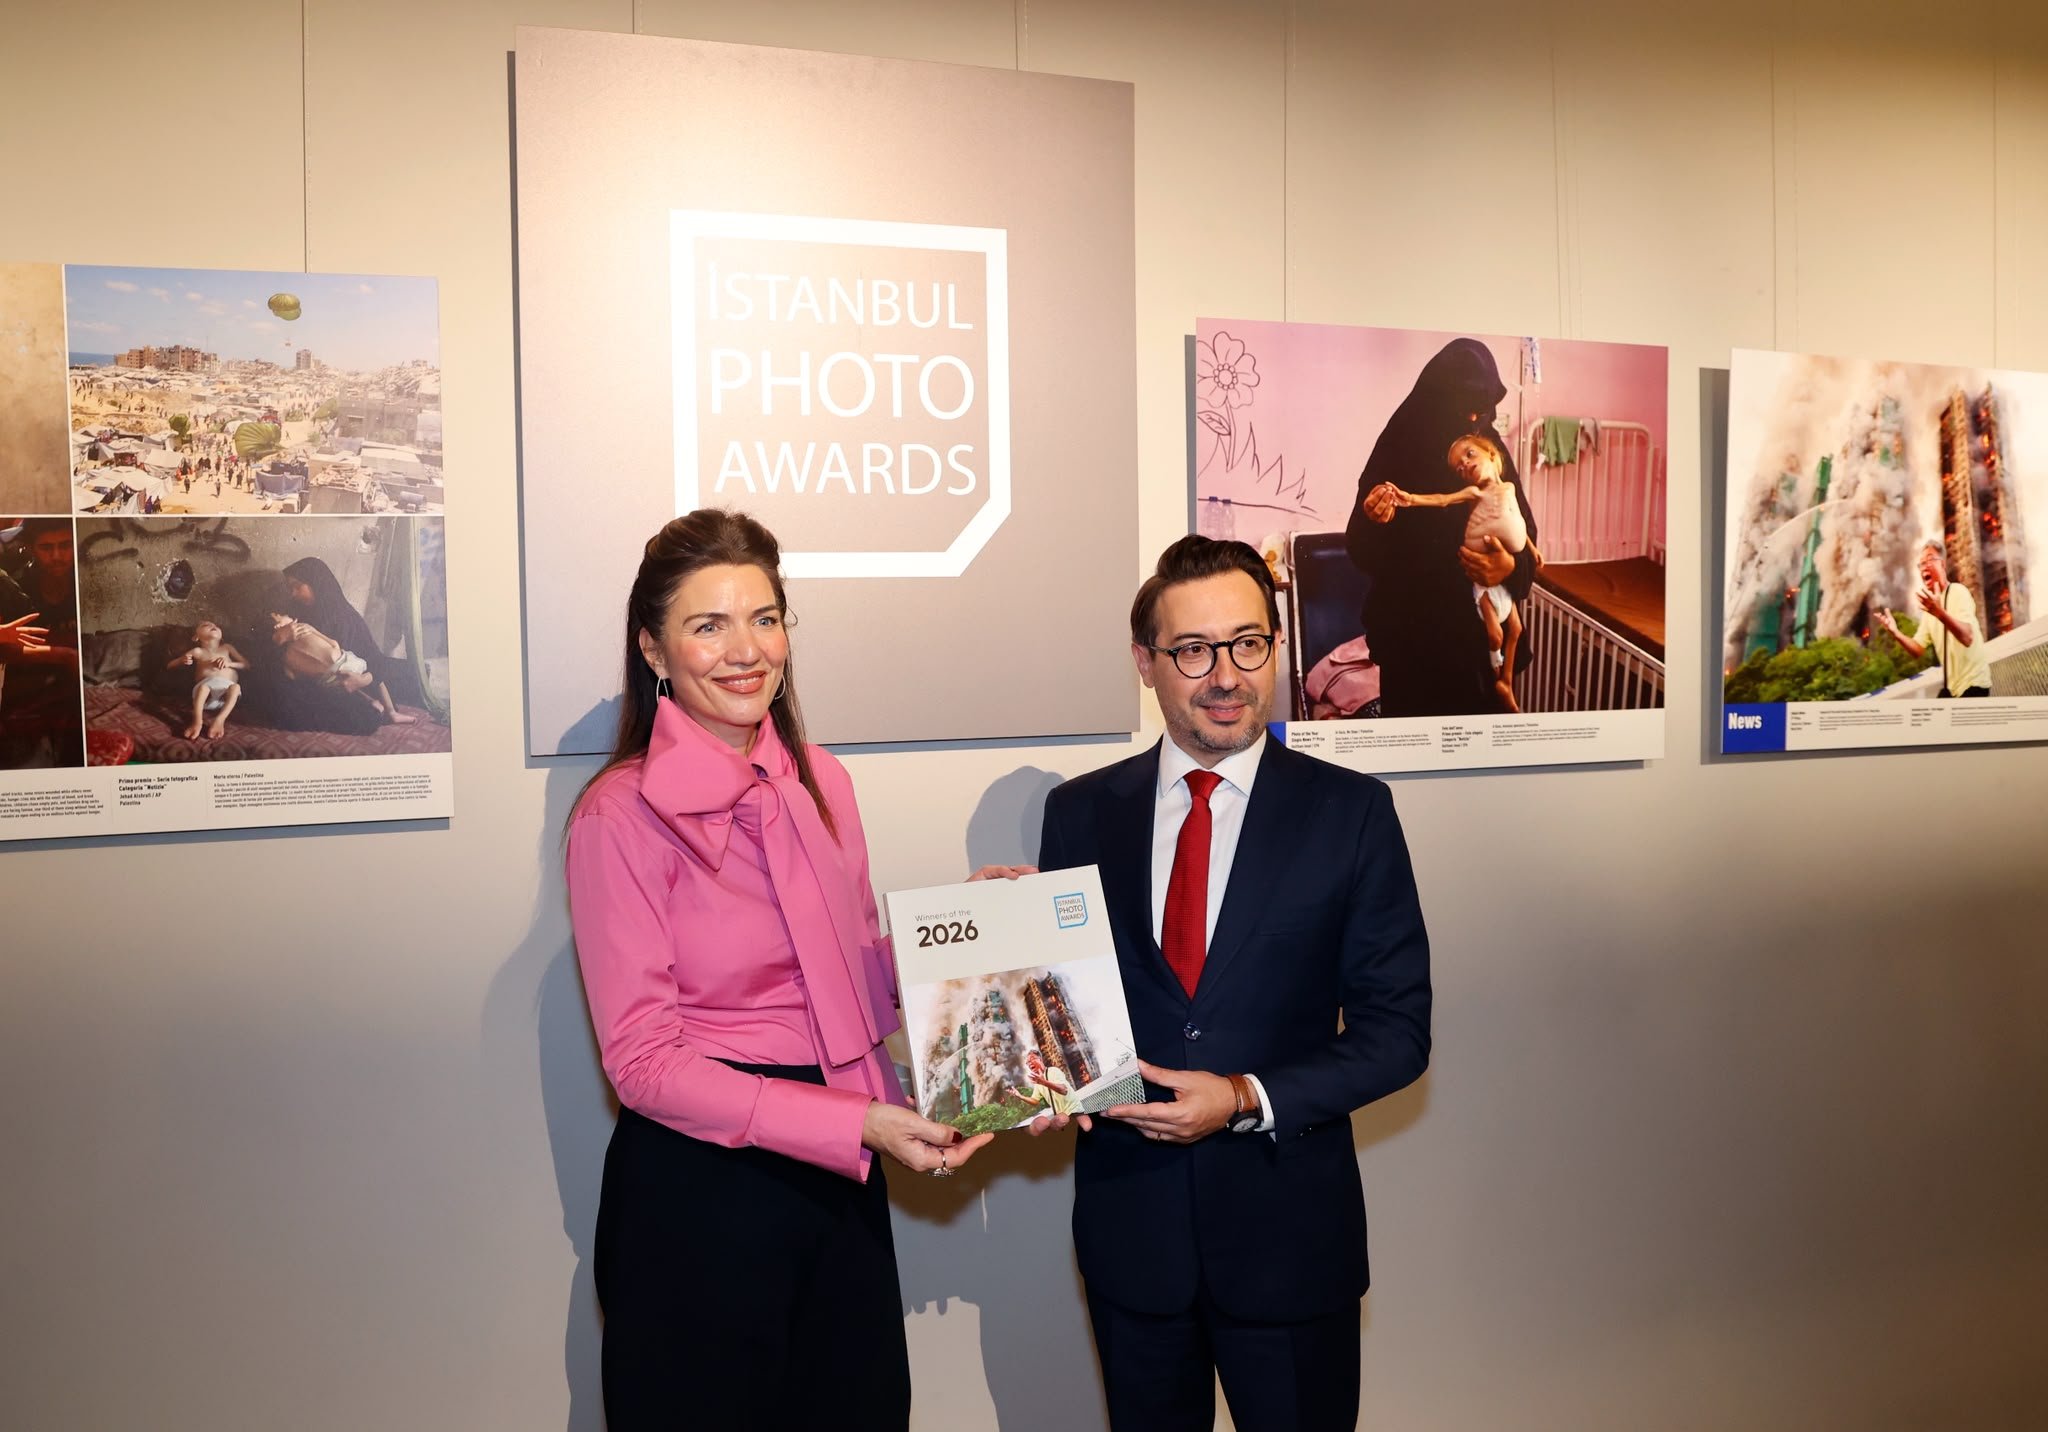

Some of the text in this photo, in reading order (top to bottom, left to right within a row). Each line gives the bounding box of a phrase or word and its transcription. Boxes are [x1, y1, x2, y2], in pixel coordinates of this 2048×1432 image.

[710, 348, 975, 421] PHOTO
[713, 441, 977, 496] AWARDS
[1728, 712, 1762, 730] News
[914, 909, 972, 922] Winners of the
[1058, 904, 1084, 914] PHOTO
[1060, 912, 1085, 921] AWARDS
[916, 919, 979, 948] 2026
